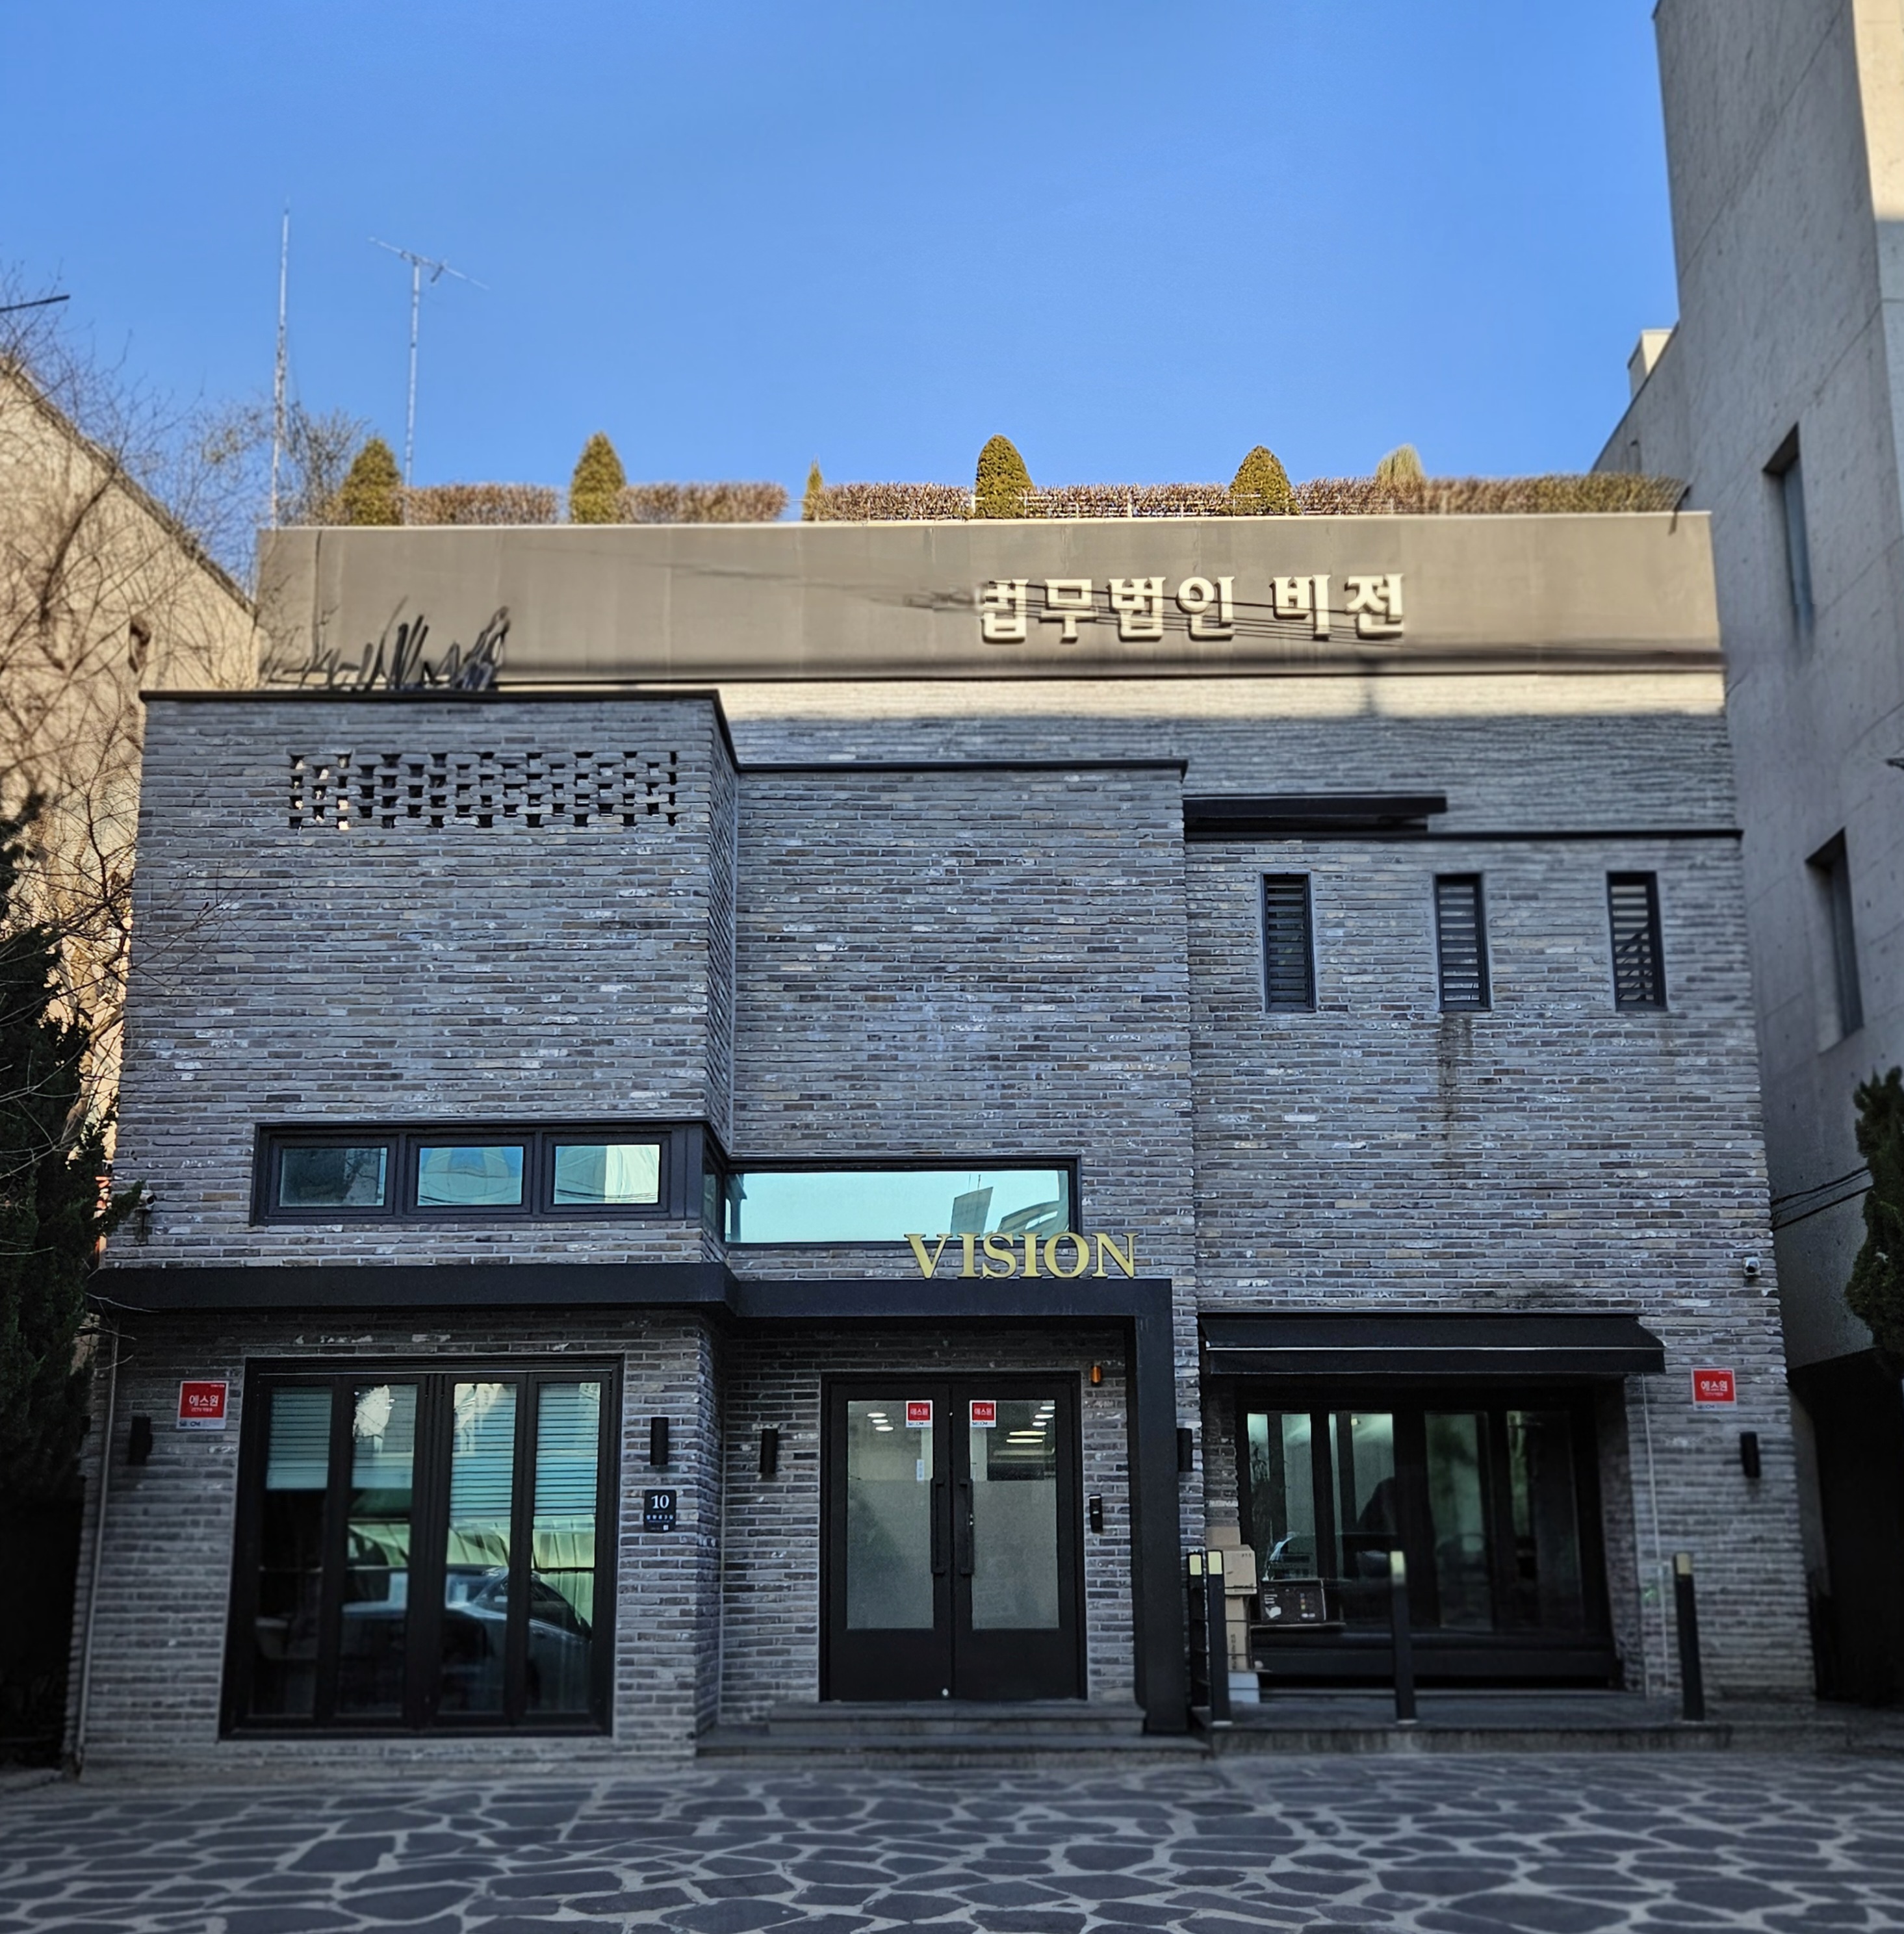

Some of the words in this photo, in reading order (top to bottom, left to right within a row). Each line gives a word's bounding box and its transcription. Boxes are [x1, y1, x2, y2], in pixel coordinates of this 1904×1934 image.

[983, 576, 1233, 642] 법무법인
[1272, 573, 1404, 641] 비전
[904, 1232, 1139, 1278] VISION
[1701, 1380, 1728, 1391] 에스원
[188, 1395, 219, 1406] 에스원
[651, 1495, 669, 1508] 10
